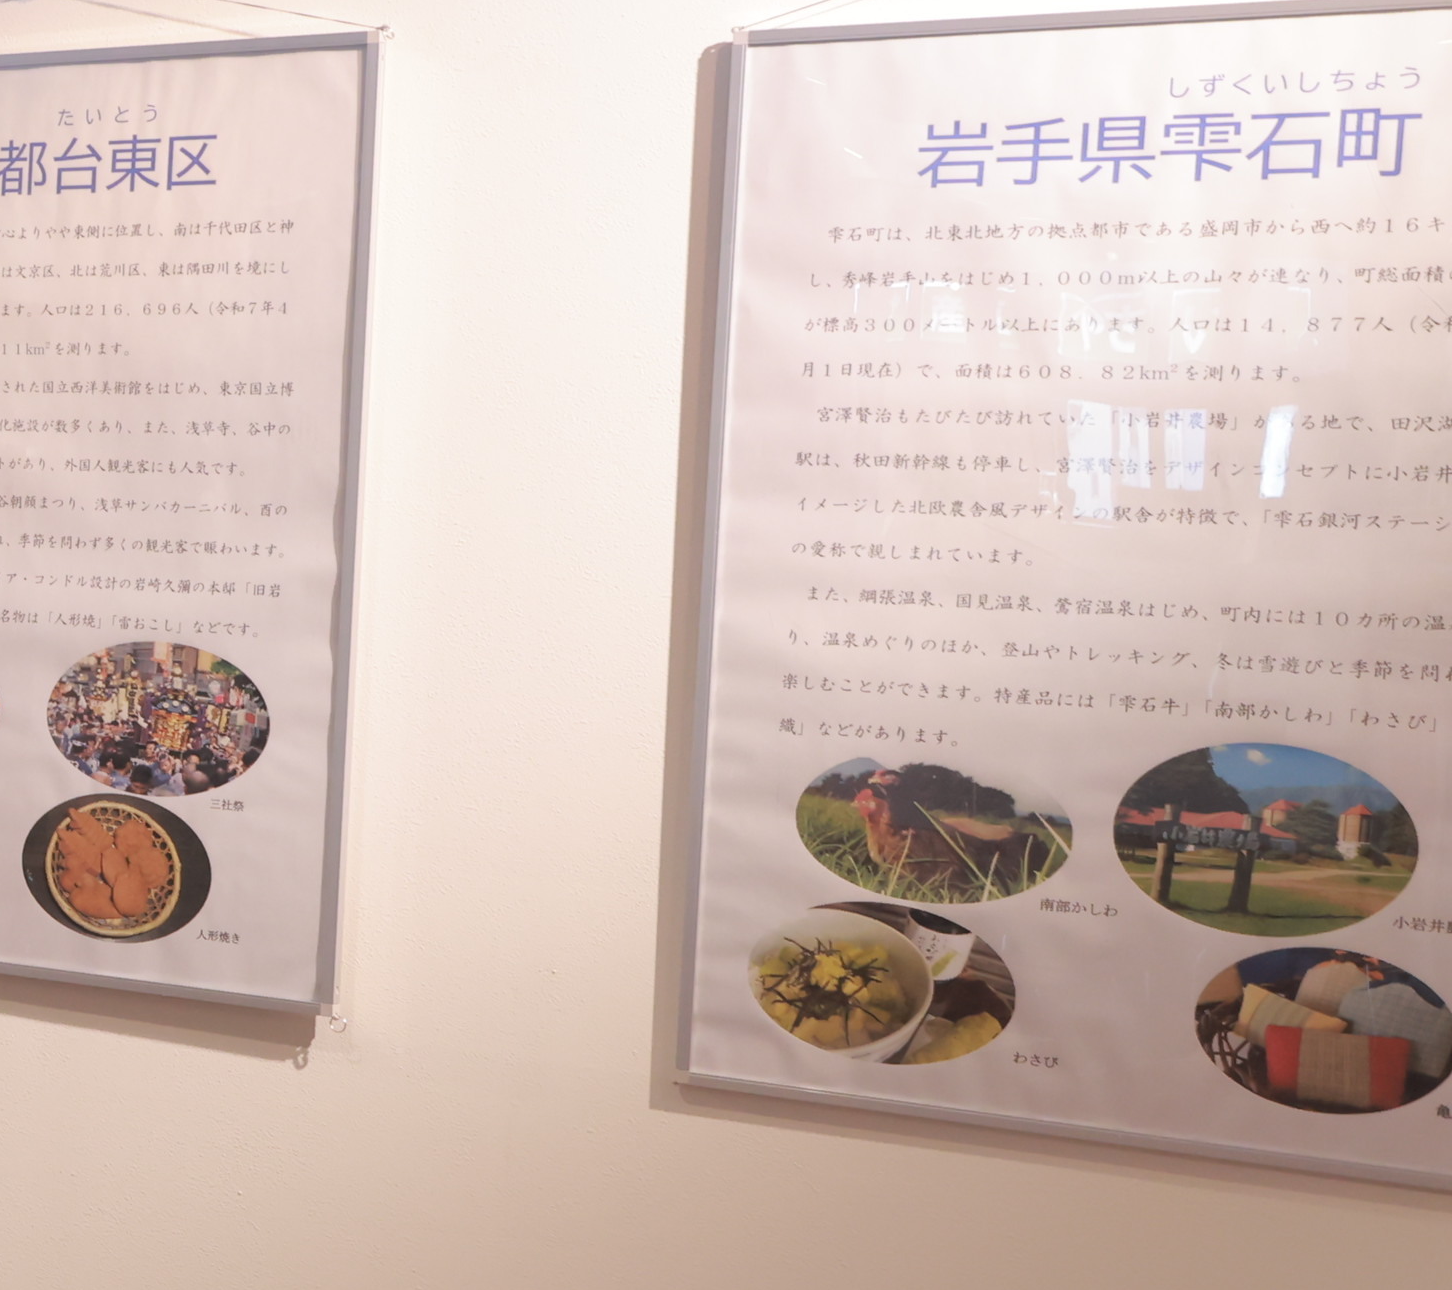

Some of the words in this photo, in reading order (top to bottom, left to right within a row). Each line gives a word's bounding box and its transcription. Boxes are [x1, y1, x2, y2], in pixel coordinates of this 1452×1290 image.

[1169, 66, 1421, 99] しずくいしちょう
[57, 104, 158, 127] たいとう
[917, 107, 1423, 189] 岩手県雫石町
[209, 797, 245, 812] 三社祭
[1040, 898, 1119, 918] 南部かしわ
[194, 928, 242, 945] 人形焼き
[1013, 1051, 1059, 1069] わさび
